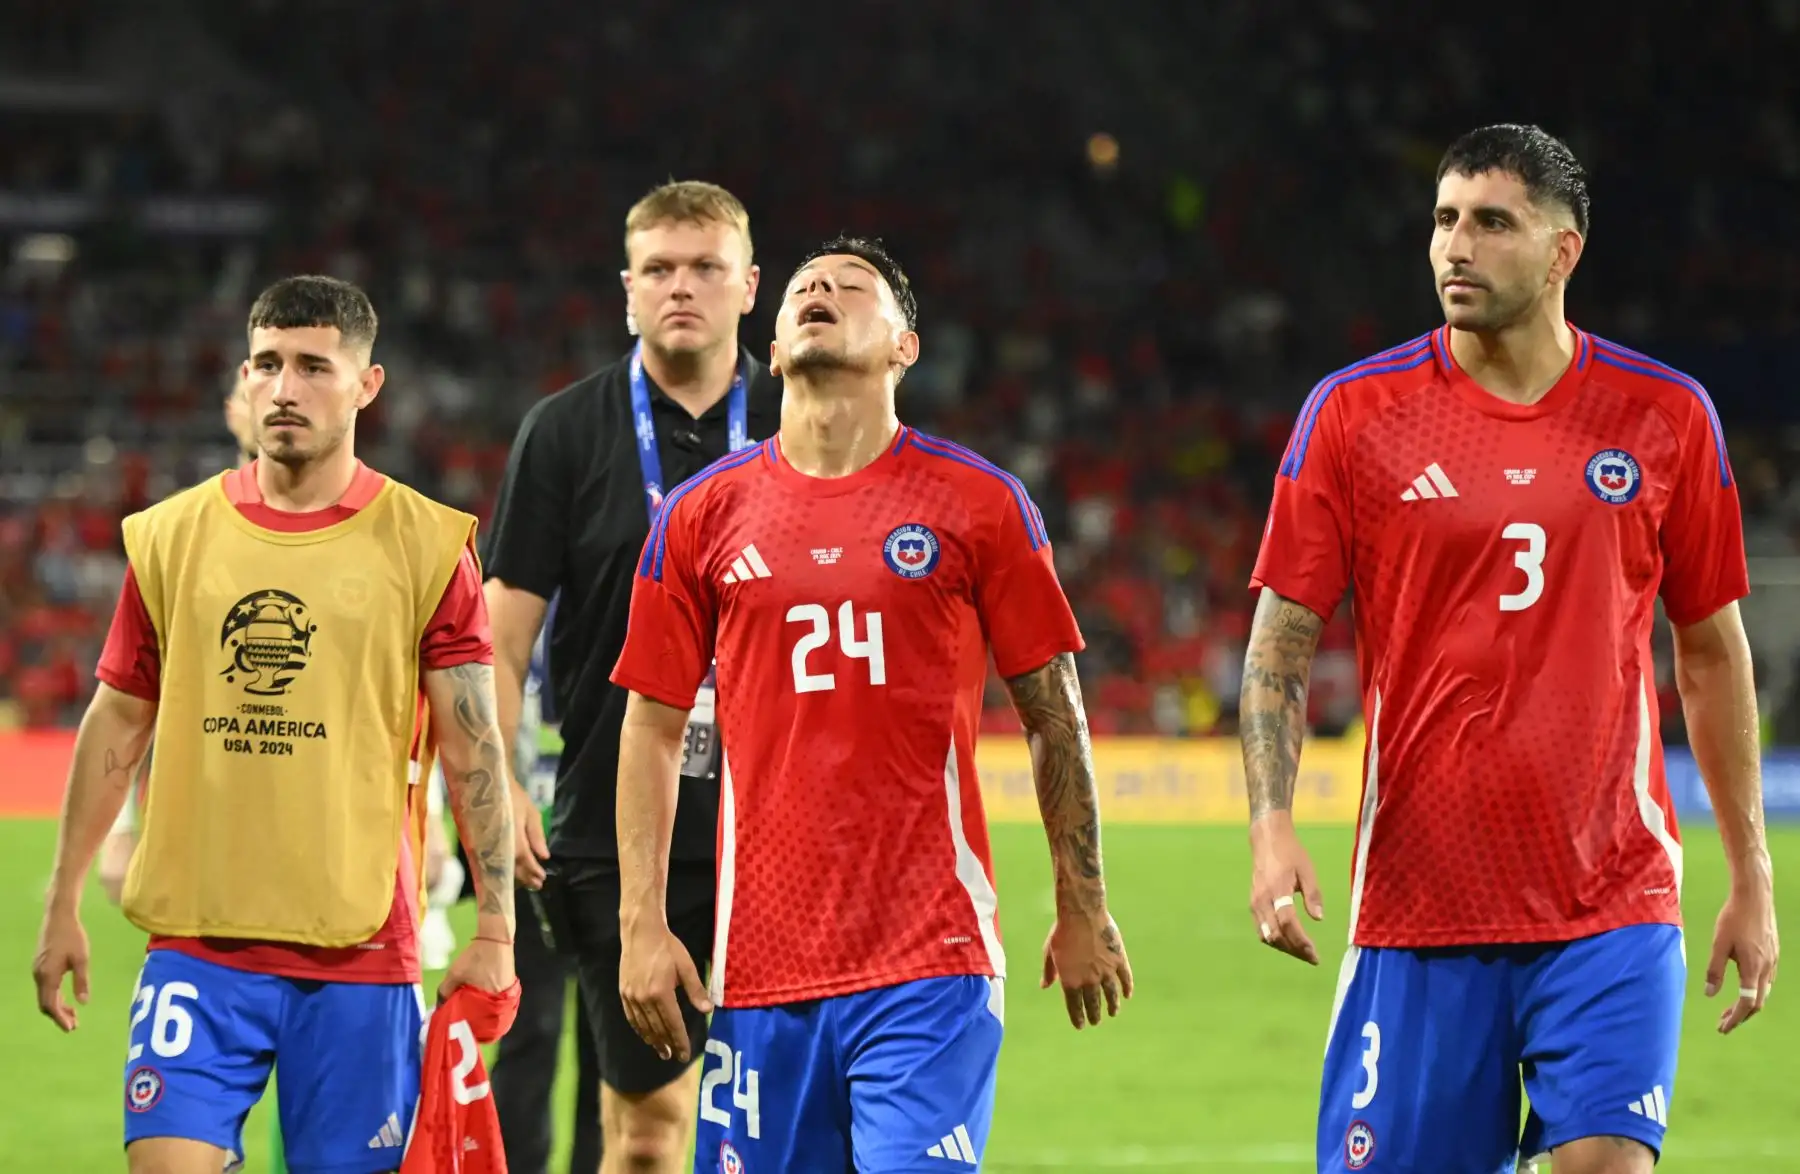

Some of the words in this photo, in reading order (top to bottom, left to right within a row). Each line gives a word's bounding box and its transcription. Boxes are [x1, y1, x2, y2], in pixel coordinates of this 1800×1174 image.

[1499, 523, 1547, 611] 3
[786, 600, 886, 694] 24
[203, 716, 241, 734] COPA
[244, 718, 327, 739] AMERICA
[223, 738, 253, 754] USA
[259, 740, 293, 756] 2024
[127, 981, 199, 1064] 26
[1351, 1020, 1381, 1110] 3
[700, 1038, 760, 1140] 24
